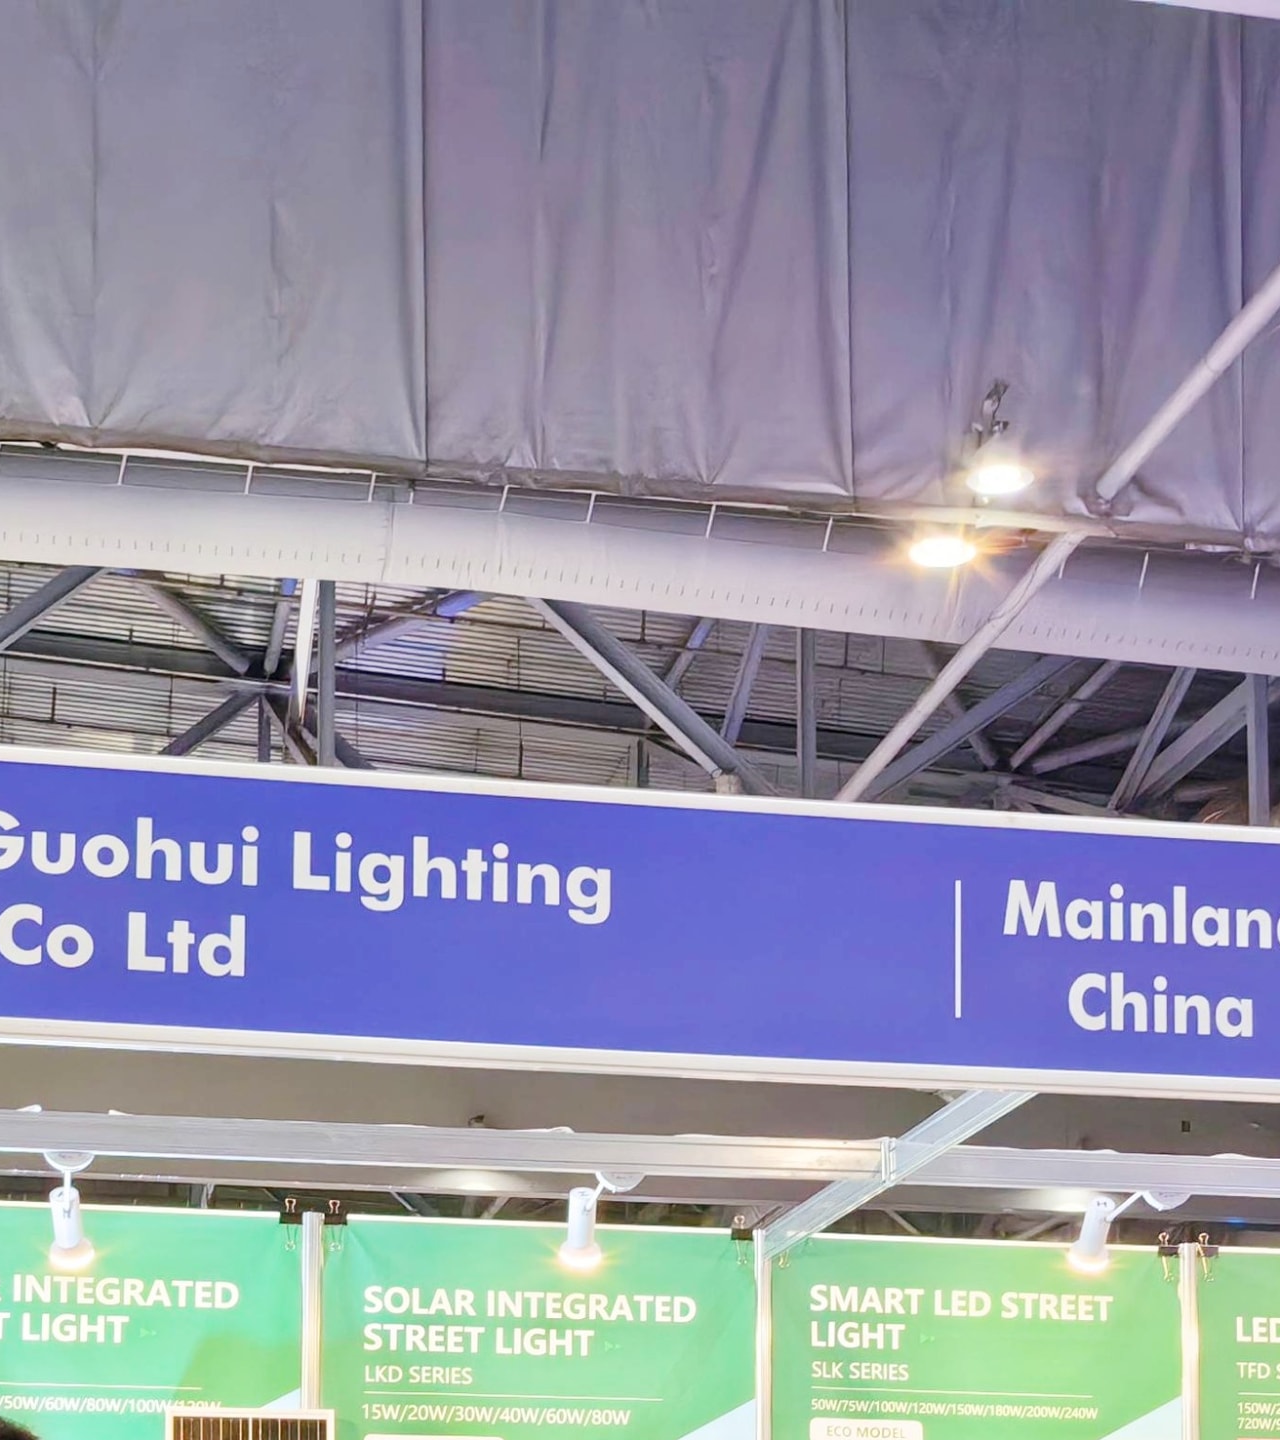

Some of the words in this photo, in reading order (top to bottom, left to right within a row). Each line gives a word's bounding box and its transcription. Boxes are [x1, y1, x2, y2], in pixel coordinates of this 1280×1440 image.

[292, 831, 612, 925] Lighting
[127, 911, 246, 977] Ltd
[1067, 972, 1253, 1038] China
[13, 1273, 239, 1309] INTEGRATED
[363, 1285, 475, 1317] SOLAR
[487, 1288, 697, 1323] INTEGRATED
[809, 1283, 924, 1316] SMART
[934, 1289, 991, 1318] LED
[1000, 1292, 1114, 1322] STREET
[21, 1312, 130, 1344] LIGHT
[363, 1322, 485, 1354] STREET
[494, 1326, 595, 1357] LIGHT
[810, 1321, 905, 1351] LIGHT
[364, 1364, 403, 1384] LKD
[408, 1366, 473, 1385] SERIES
[811, 1361, 844, 1380] SLK
[849, 1362, 909, 1382] SERIES
[1236, 1362, 1271, 1380] TFD
[361, 1403, 631, 1426] 15W/20W/30W/40W/60W/80W
[826, 1425, 852, 1438] ECO
[856, 1425, 906, 1440] MODEL
